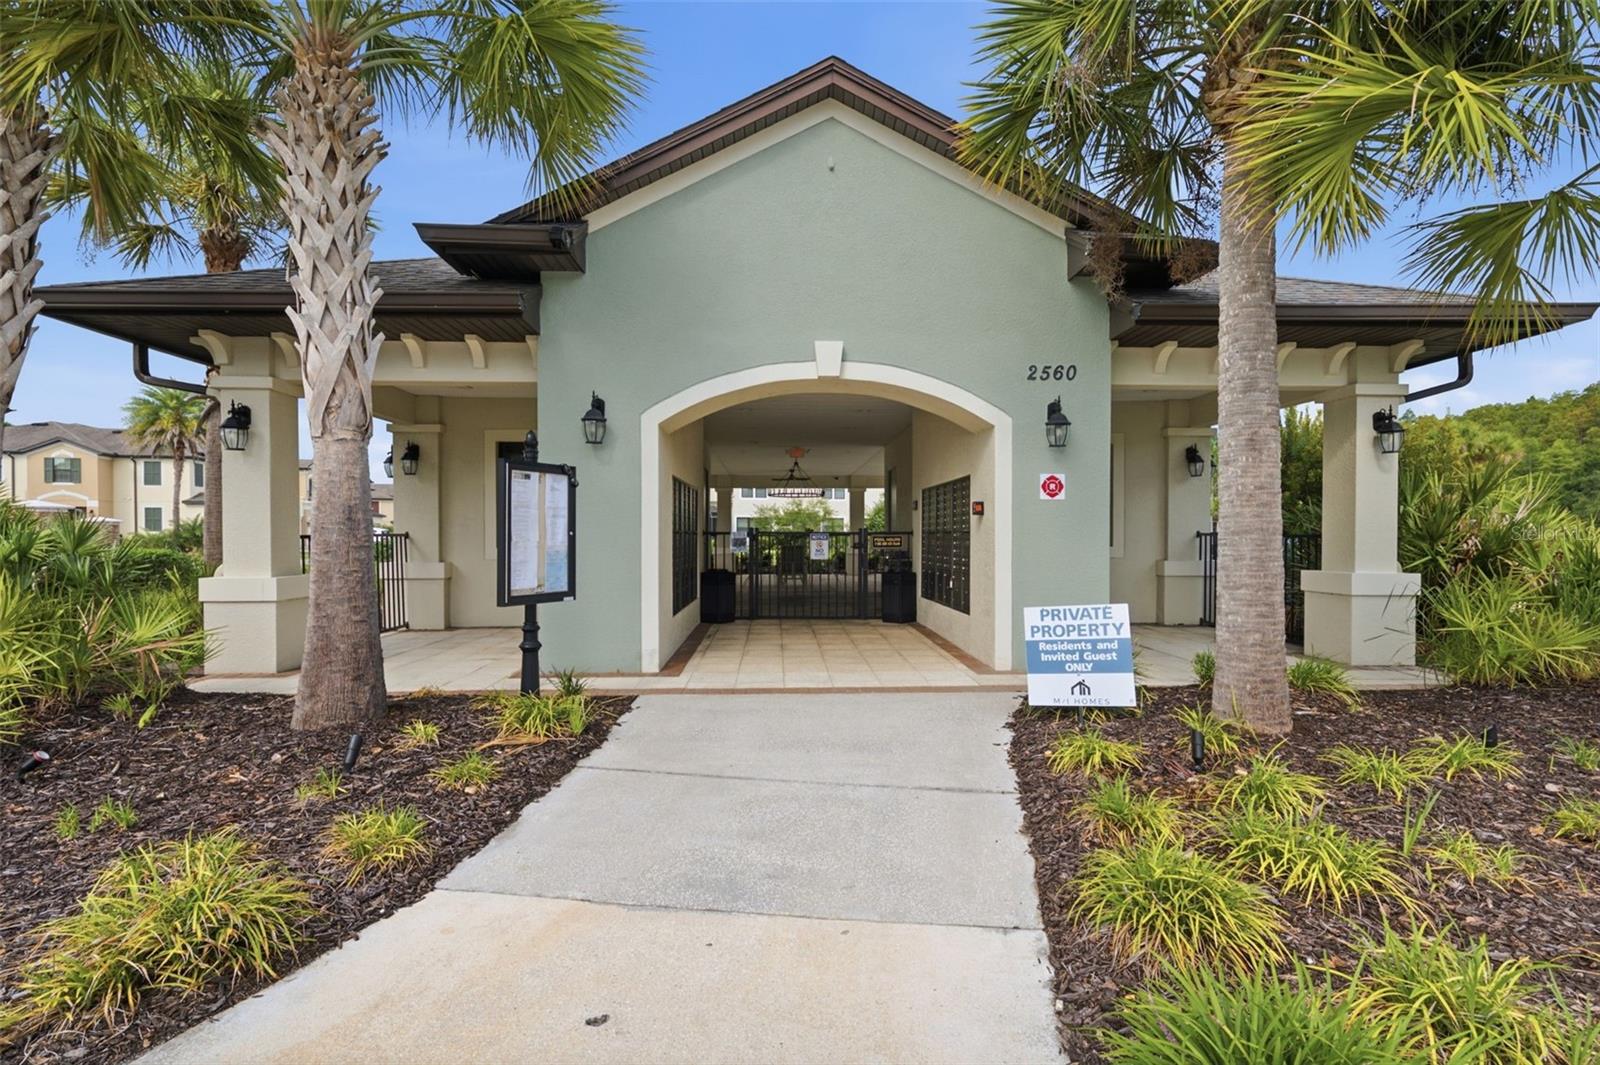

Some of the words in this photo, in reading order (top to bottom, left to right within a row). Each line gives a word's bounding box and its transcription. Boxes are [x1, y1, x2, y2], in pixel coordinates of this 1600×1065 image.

[1027, 364, 1077, 381] 2560
[1040, 606, 1113, 622] PRIVATE
[1030, 622, 1124, 638] PROPERTY
[1039, 642, 1092, 651] Residents
[1097, 640, 1118, 649] and
[1041, 652, 1079, 662] Invited
[1083, 651, 1118, 661] Guest
[1065, 662, 1093, 672] ONLY
